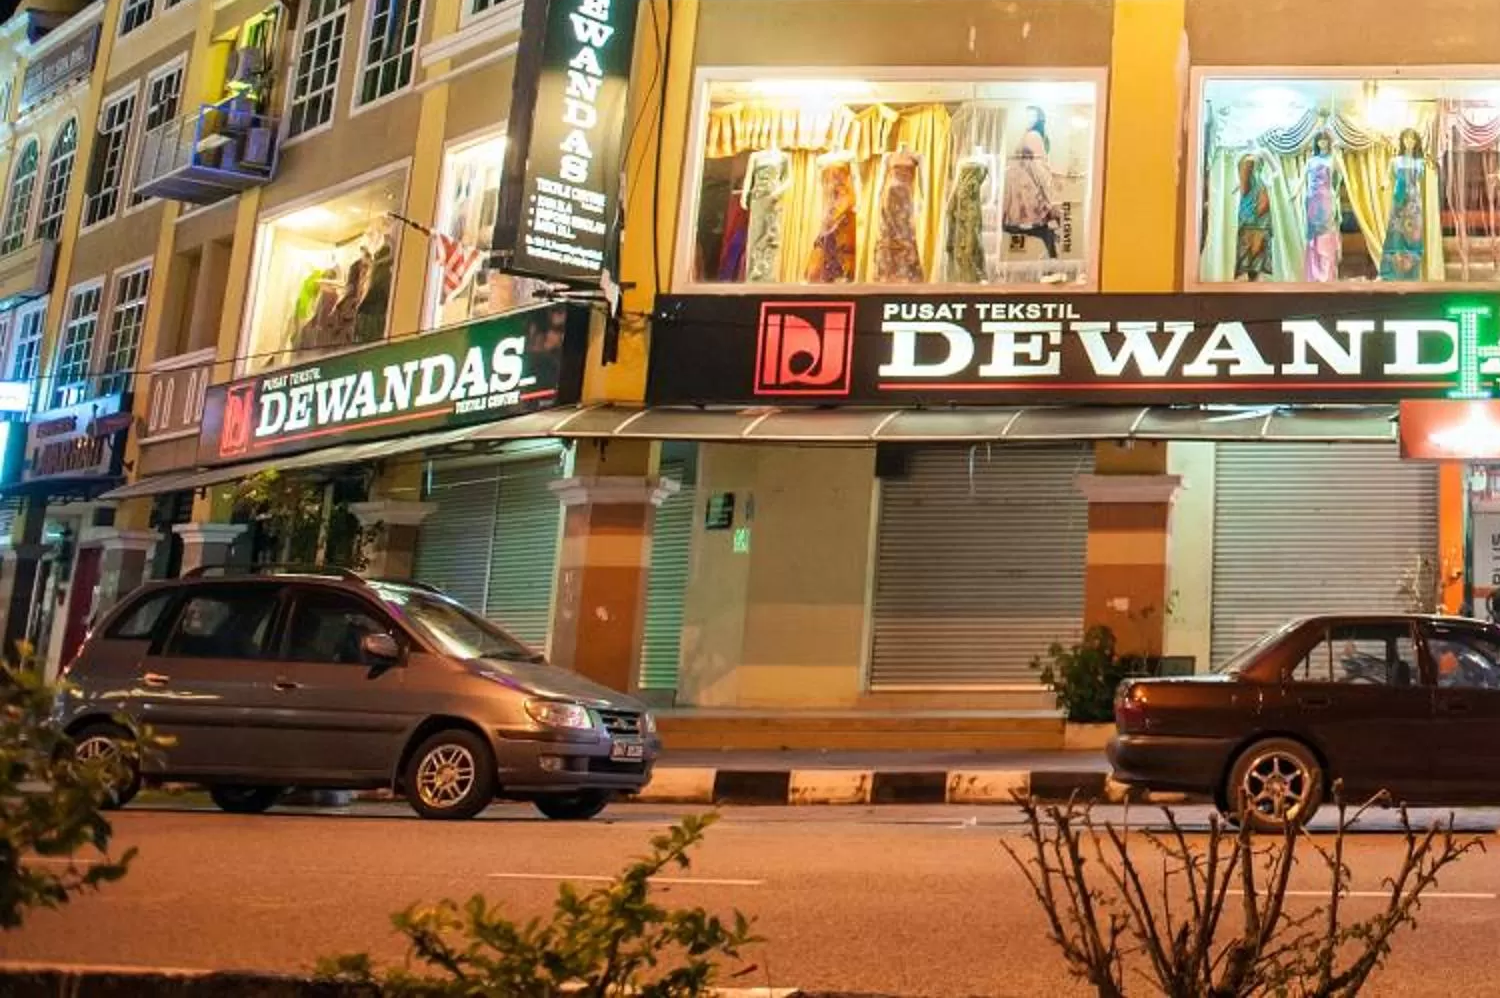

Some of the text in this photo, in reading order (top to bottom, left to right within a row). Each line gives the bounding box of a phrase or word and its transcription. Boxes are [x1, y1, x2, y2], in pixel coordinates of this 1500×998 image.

[883, 303, 1081, 320] PUSAT TEKSTIL
[255, 336, 527, 437] DEWANDAS
